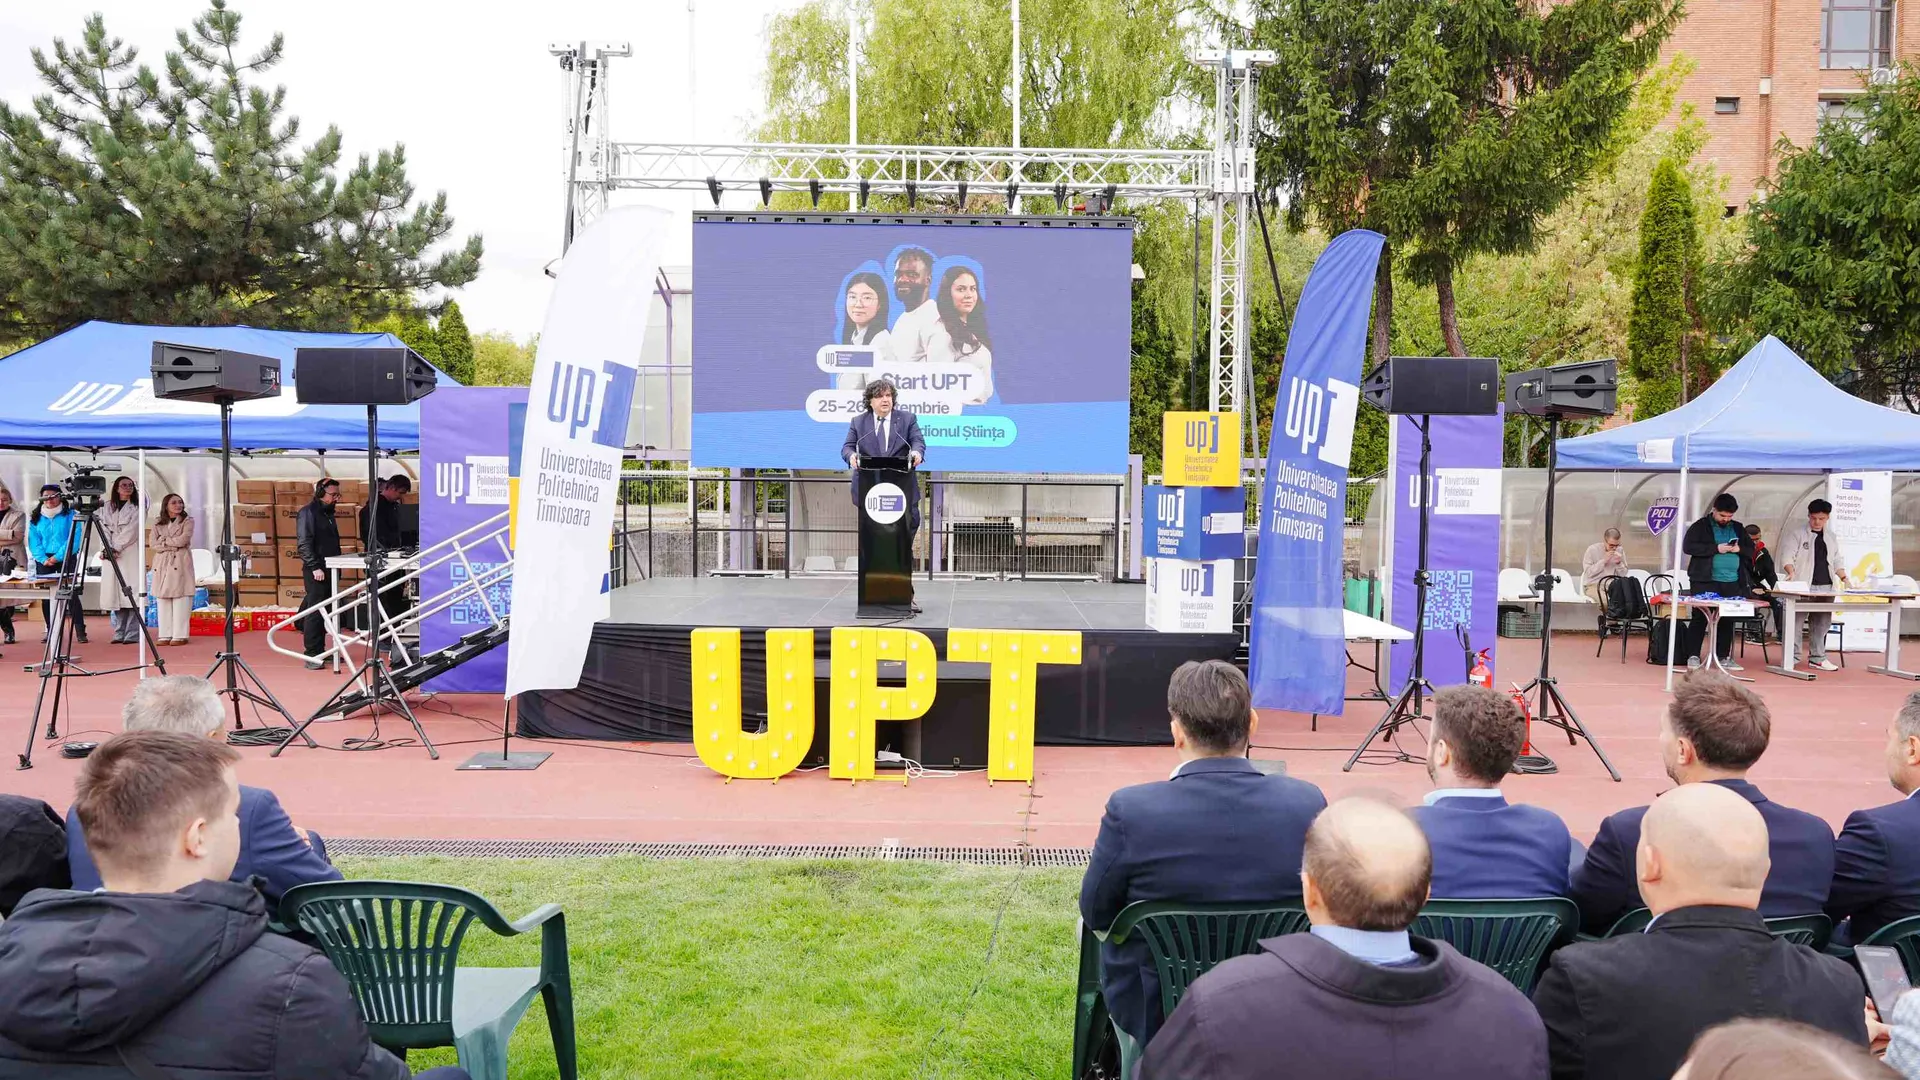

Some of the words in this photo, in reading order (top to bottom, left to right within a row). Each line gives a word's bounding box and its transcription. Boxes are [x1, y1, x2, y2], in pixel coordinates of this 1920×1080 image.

[931, 373, 972, 390] UPT
[895, 401, 950, 414] tembrie
[919, 424, 960, 438] dionul
[540, 447, 613, 481] Universitatea
[1277, 459, 1337, 498] Universitatea
[537, 473, 599, 503] Politehnica
[1274, 485, 1327, 519] Politehnica
[536, 498, 591, 527] Timișoara
[1271, 510, 1324, 542] Timișoara
[1651, 508, 1673, 518] POLI
[1652, 519, 1666, 530] T
[690, 626, 1083, 781] UPT
